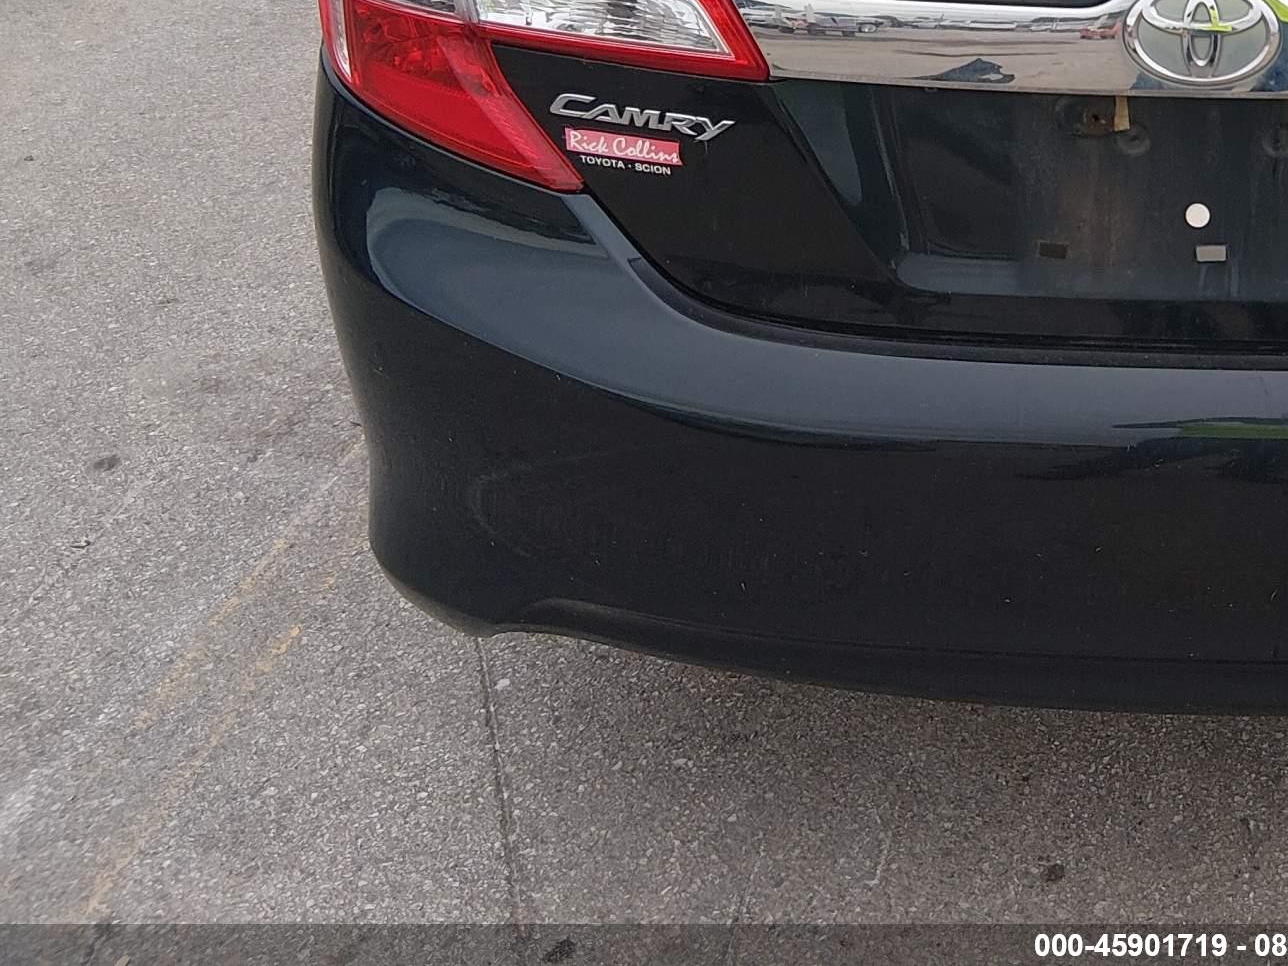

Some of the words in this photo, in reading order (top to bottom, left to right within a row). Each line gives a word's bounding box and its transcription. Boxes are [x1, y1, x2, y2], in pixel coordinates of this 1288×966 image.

[550, 93, 736, 142] CAMRY
[569, 130, 608, 152] Rick
[613, 137, 679, 163] Collins
[580, 155, 625, 169] TOYOTA
[635, 163, 671, 175] SCION
